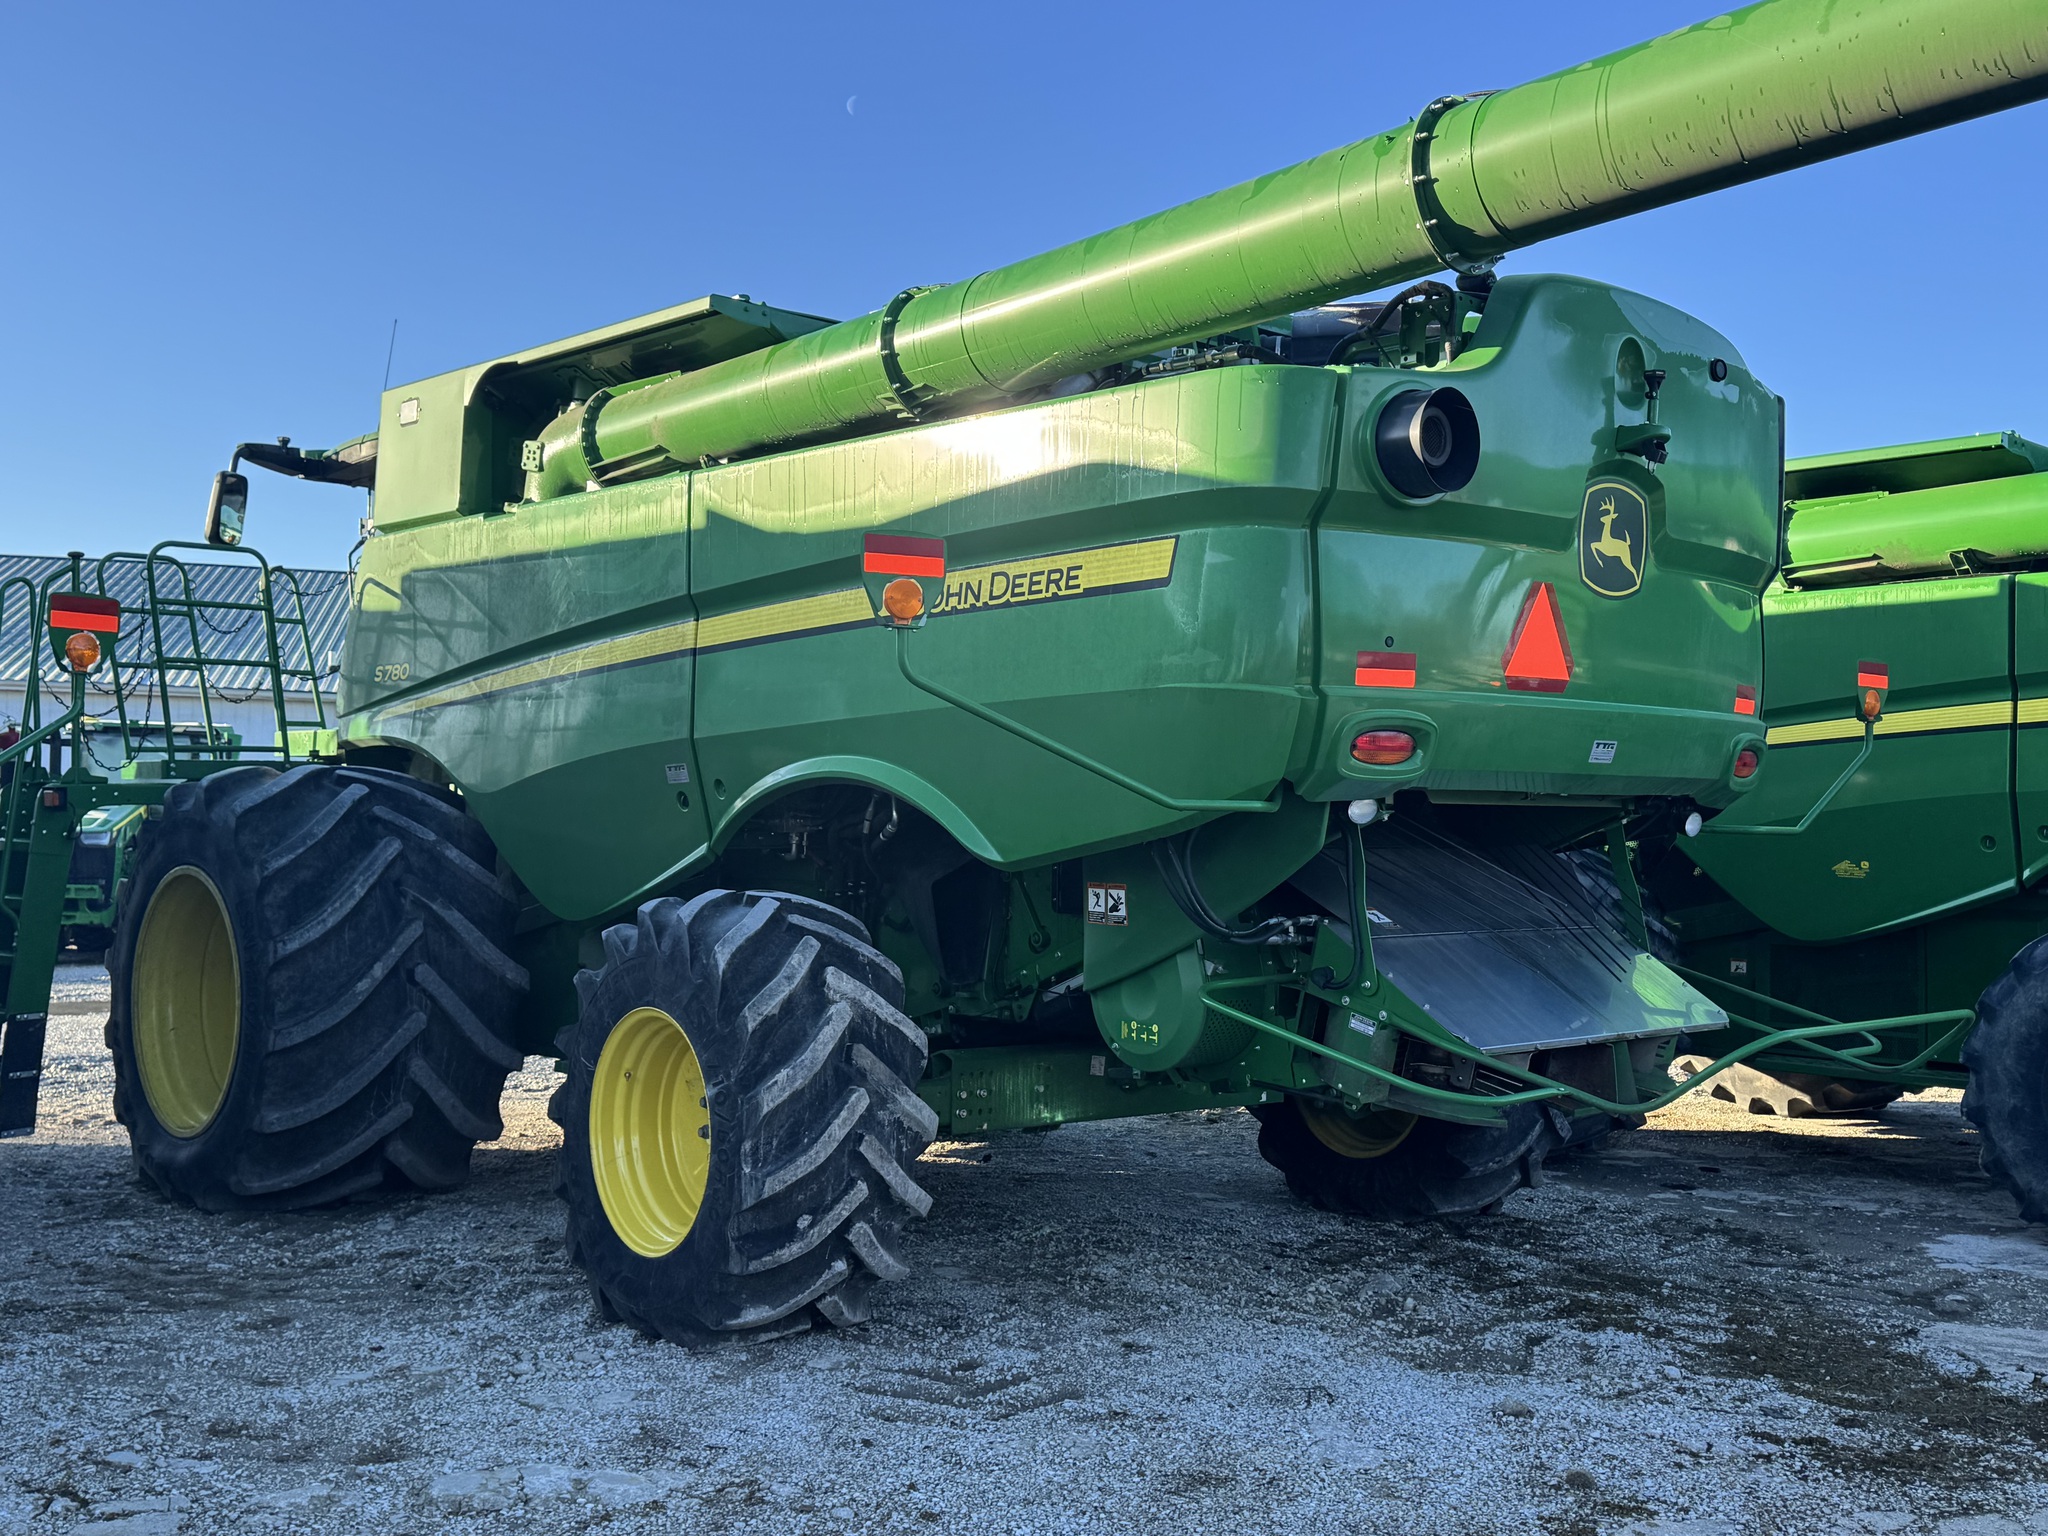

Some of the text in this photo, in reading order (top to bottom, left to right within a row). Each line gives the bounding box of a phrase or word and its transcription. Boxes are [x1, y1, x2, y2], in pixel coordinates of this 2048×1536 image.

[934, 565, 1083, 609] HN DEERE
[374, 663, 410, 682] S780
